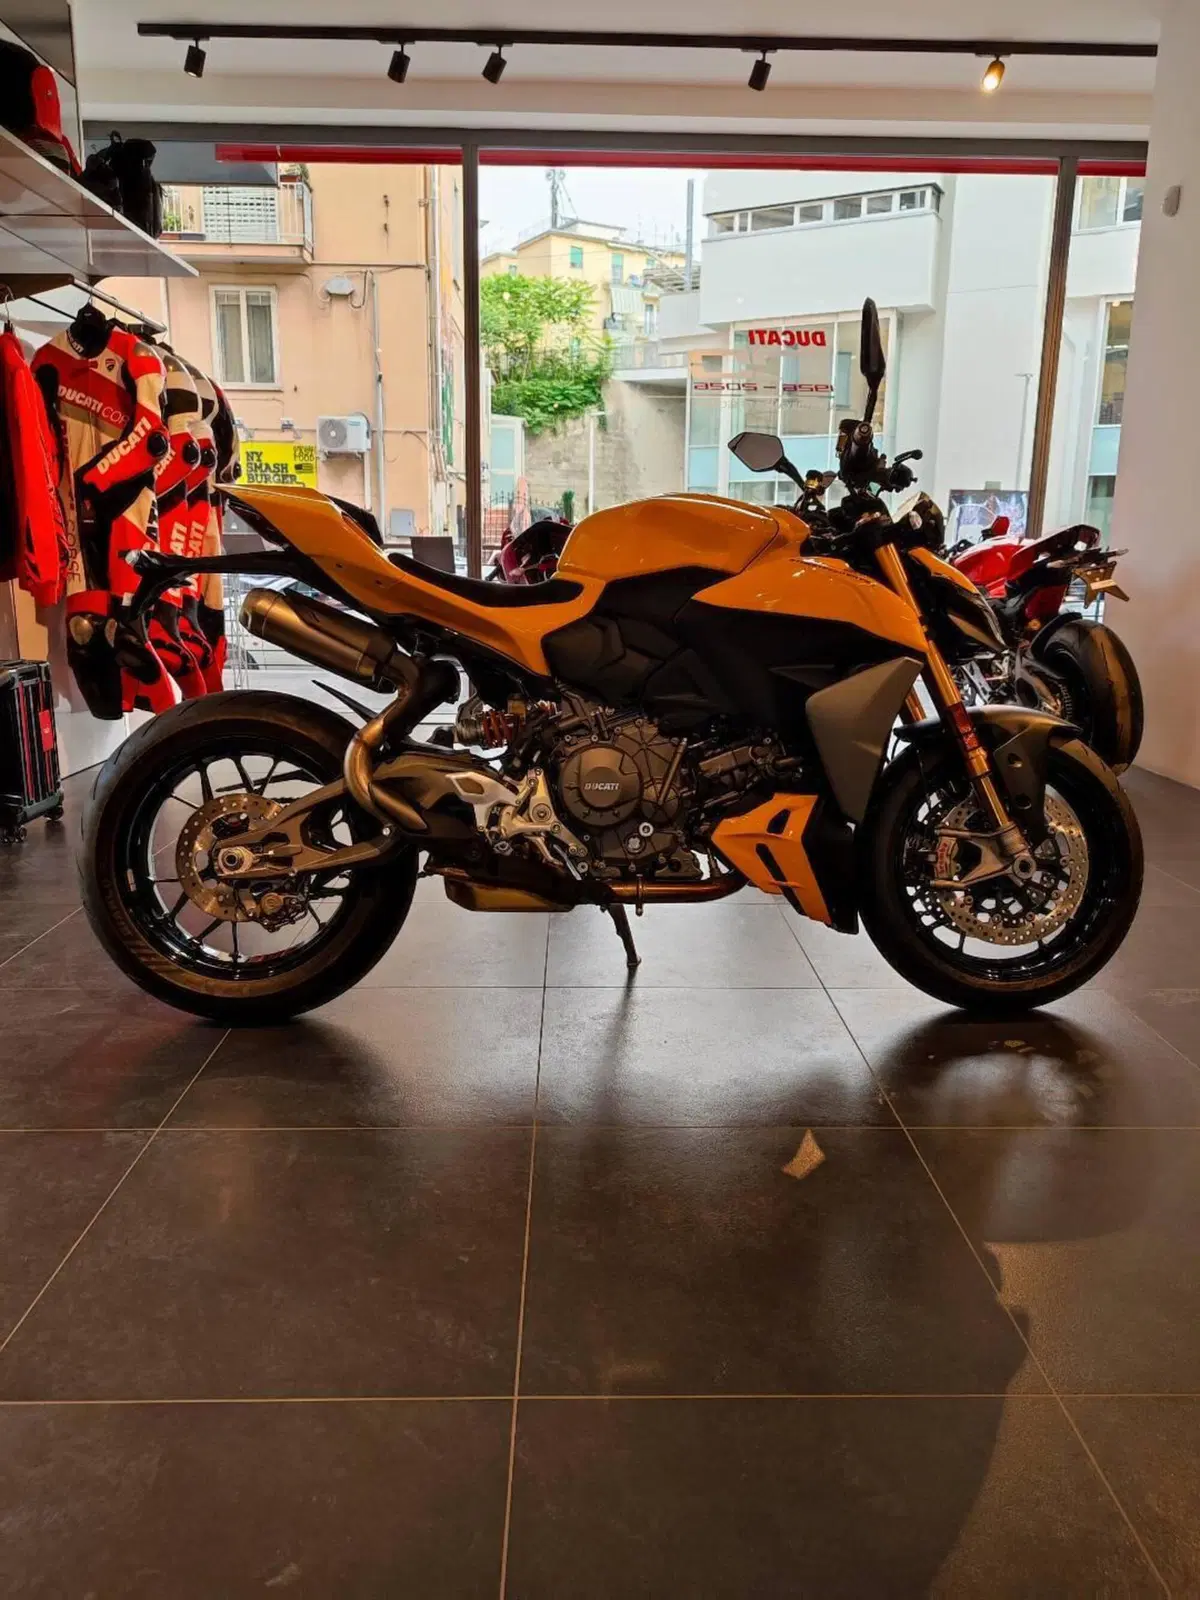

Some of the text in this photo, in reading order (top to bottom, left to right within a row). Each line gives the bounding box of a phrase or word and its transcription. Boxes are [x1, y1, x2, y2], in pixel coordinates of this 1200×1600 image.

[57, 385, 103, 413] DUCATI
[97, 416, 152, 475] DUCATI
[153, 447, 176, 476] CATI
[246, 451, 263, 462] NY
[246, 462, 289, 473] SMASH
[247, 474, 297, 484] BURGER
[584, 782, 619, 790] DUCATI
